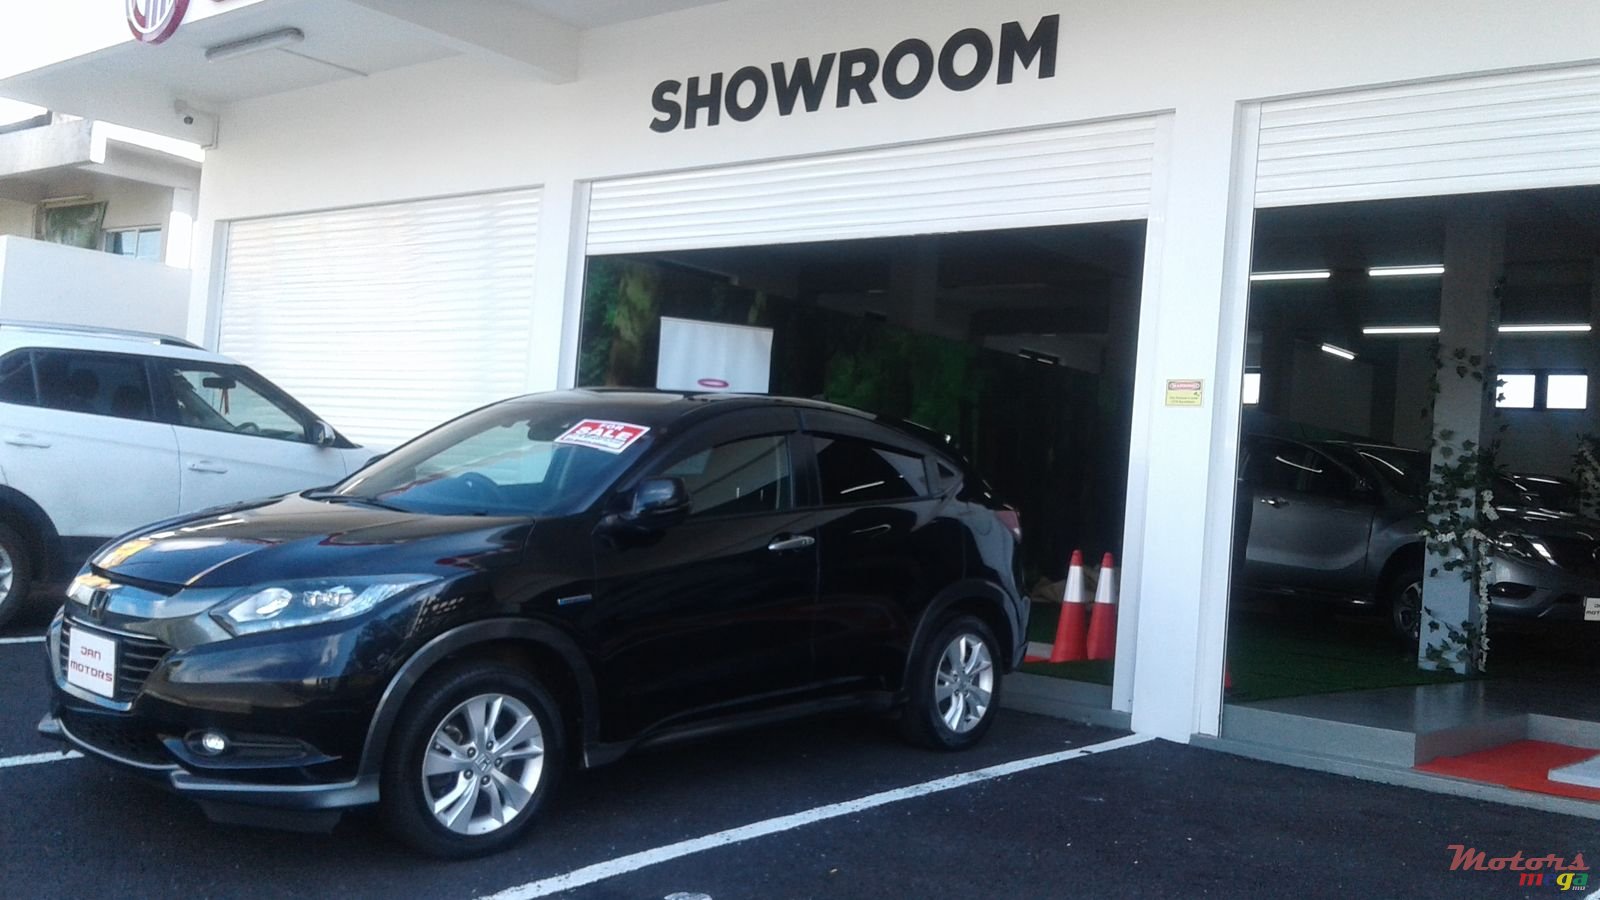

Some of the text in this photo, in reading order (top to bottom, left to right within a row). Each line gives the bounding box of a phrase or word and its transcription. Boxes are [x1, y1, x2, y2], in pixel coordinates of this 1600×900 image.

[649, 14, 1060, 133] SHOWROOM
[574, 427, 633, 440] SALE
[80, 646, 102, 660] JAN
[70, 660, 113, 682] MOTORS
